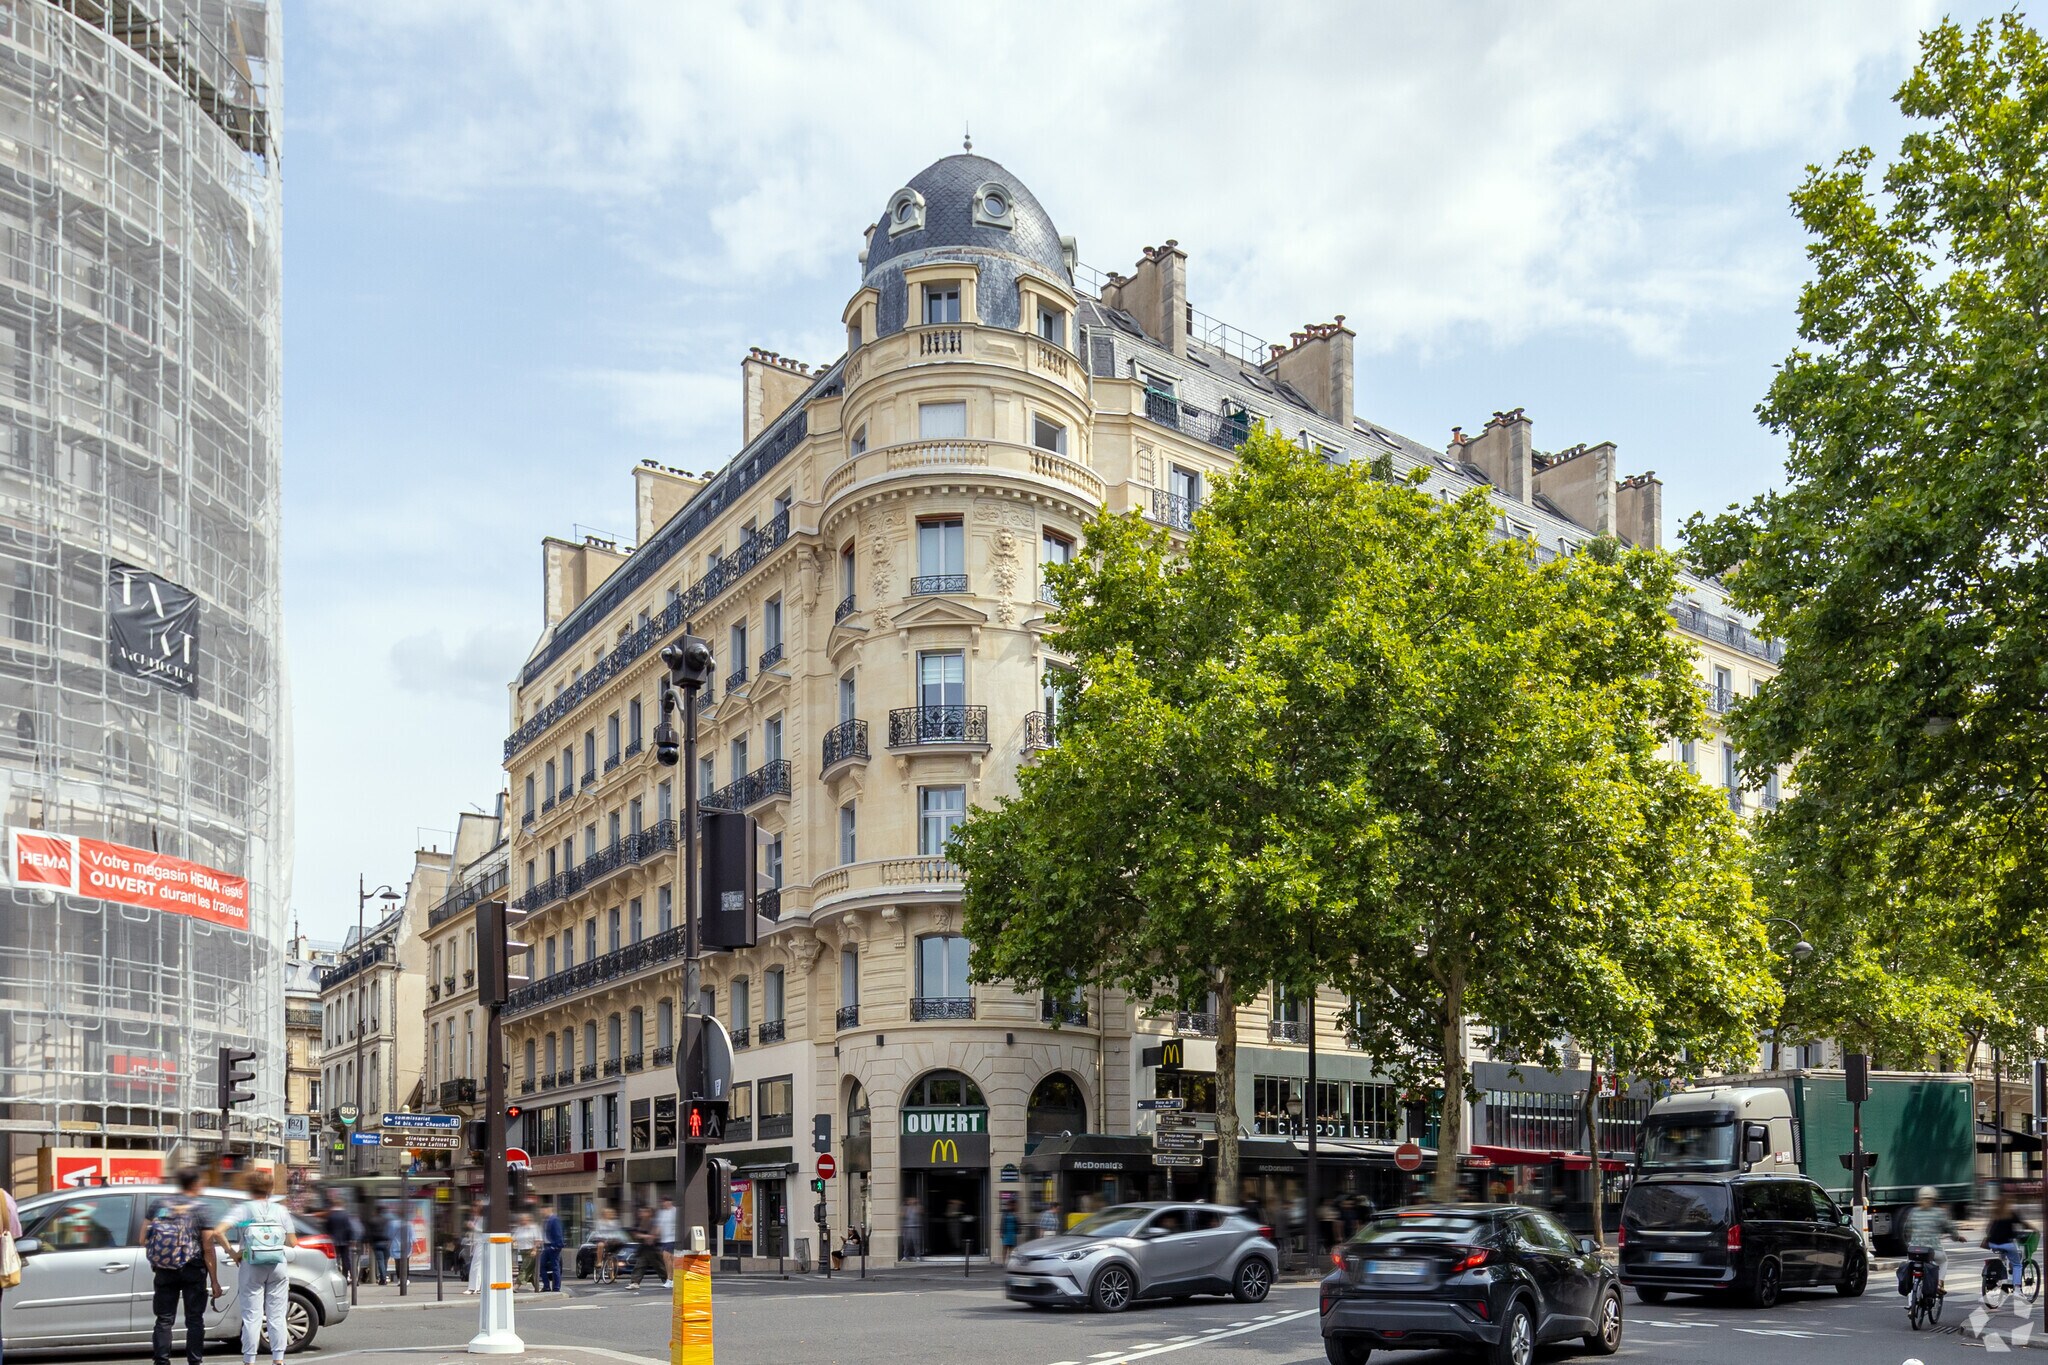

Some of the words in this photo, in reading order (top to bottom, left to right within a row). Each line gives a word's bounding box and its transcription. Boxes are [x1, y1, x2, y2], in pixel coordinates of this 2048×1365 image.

[20, 851, 70, 871] HEMA
[89, 849, 130, 872] Votre
[133, 861, 188, 884] magasin
[190, 870, 221, 894] HEMA
[221, 883, 244, 900] reste
[90, 870, 157, 896] OUVERT
[159, 886, 198, 907] durant
[197, 892, 212, 910] les
[212, 899, 245, 918] travaux
[341, 1106, 356, 1115] BUS
[907, 1113, 980, 1132] OUVERT
[1073, 1161, 1123, 1169] McDonald's
